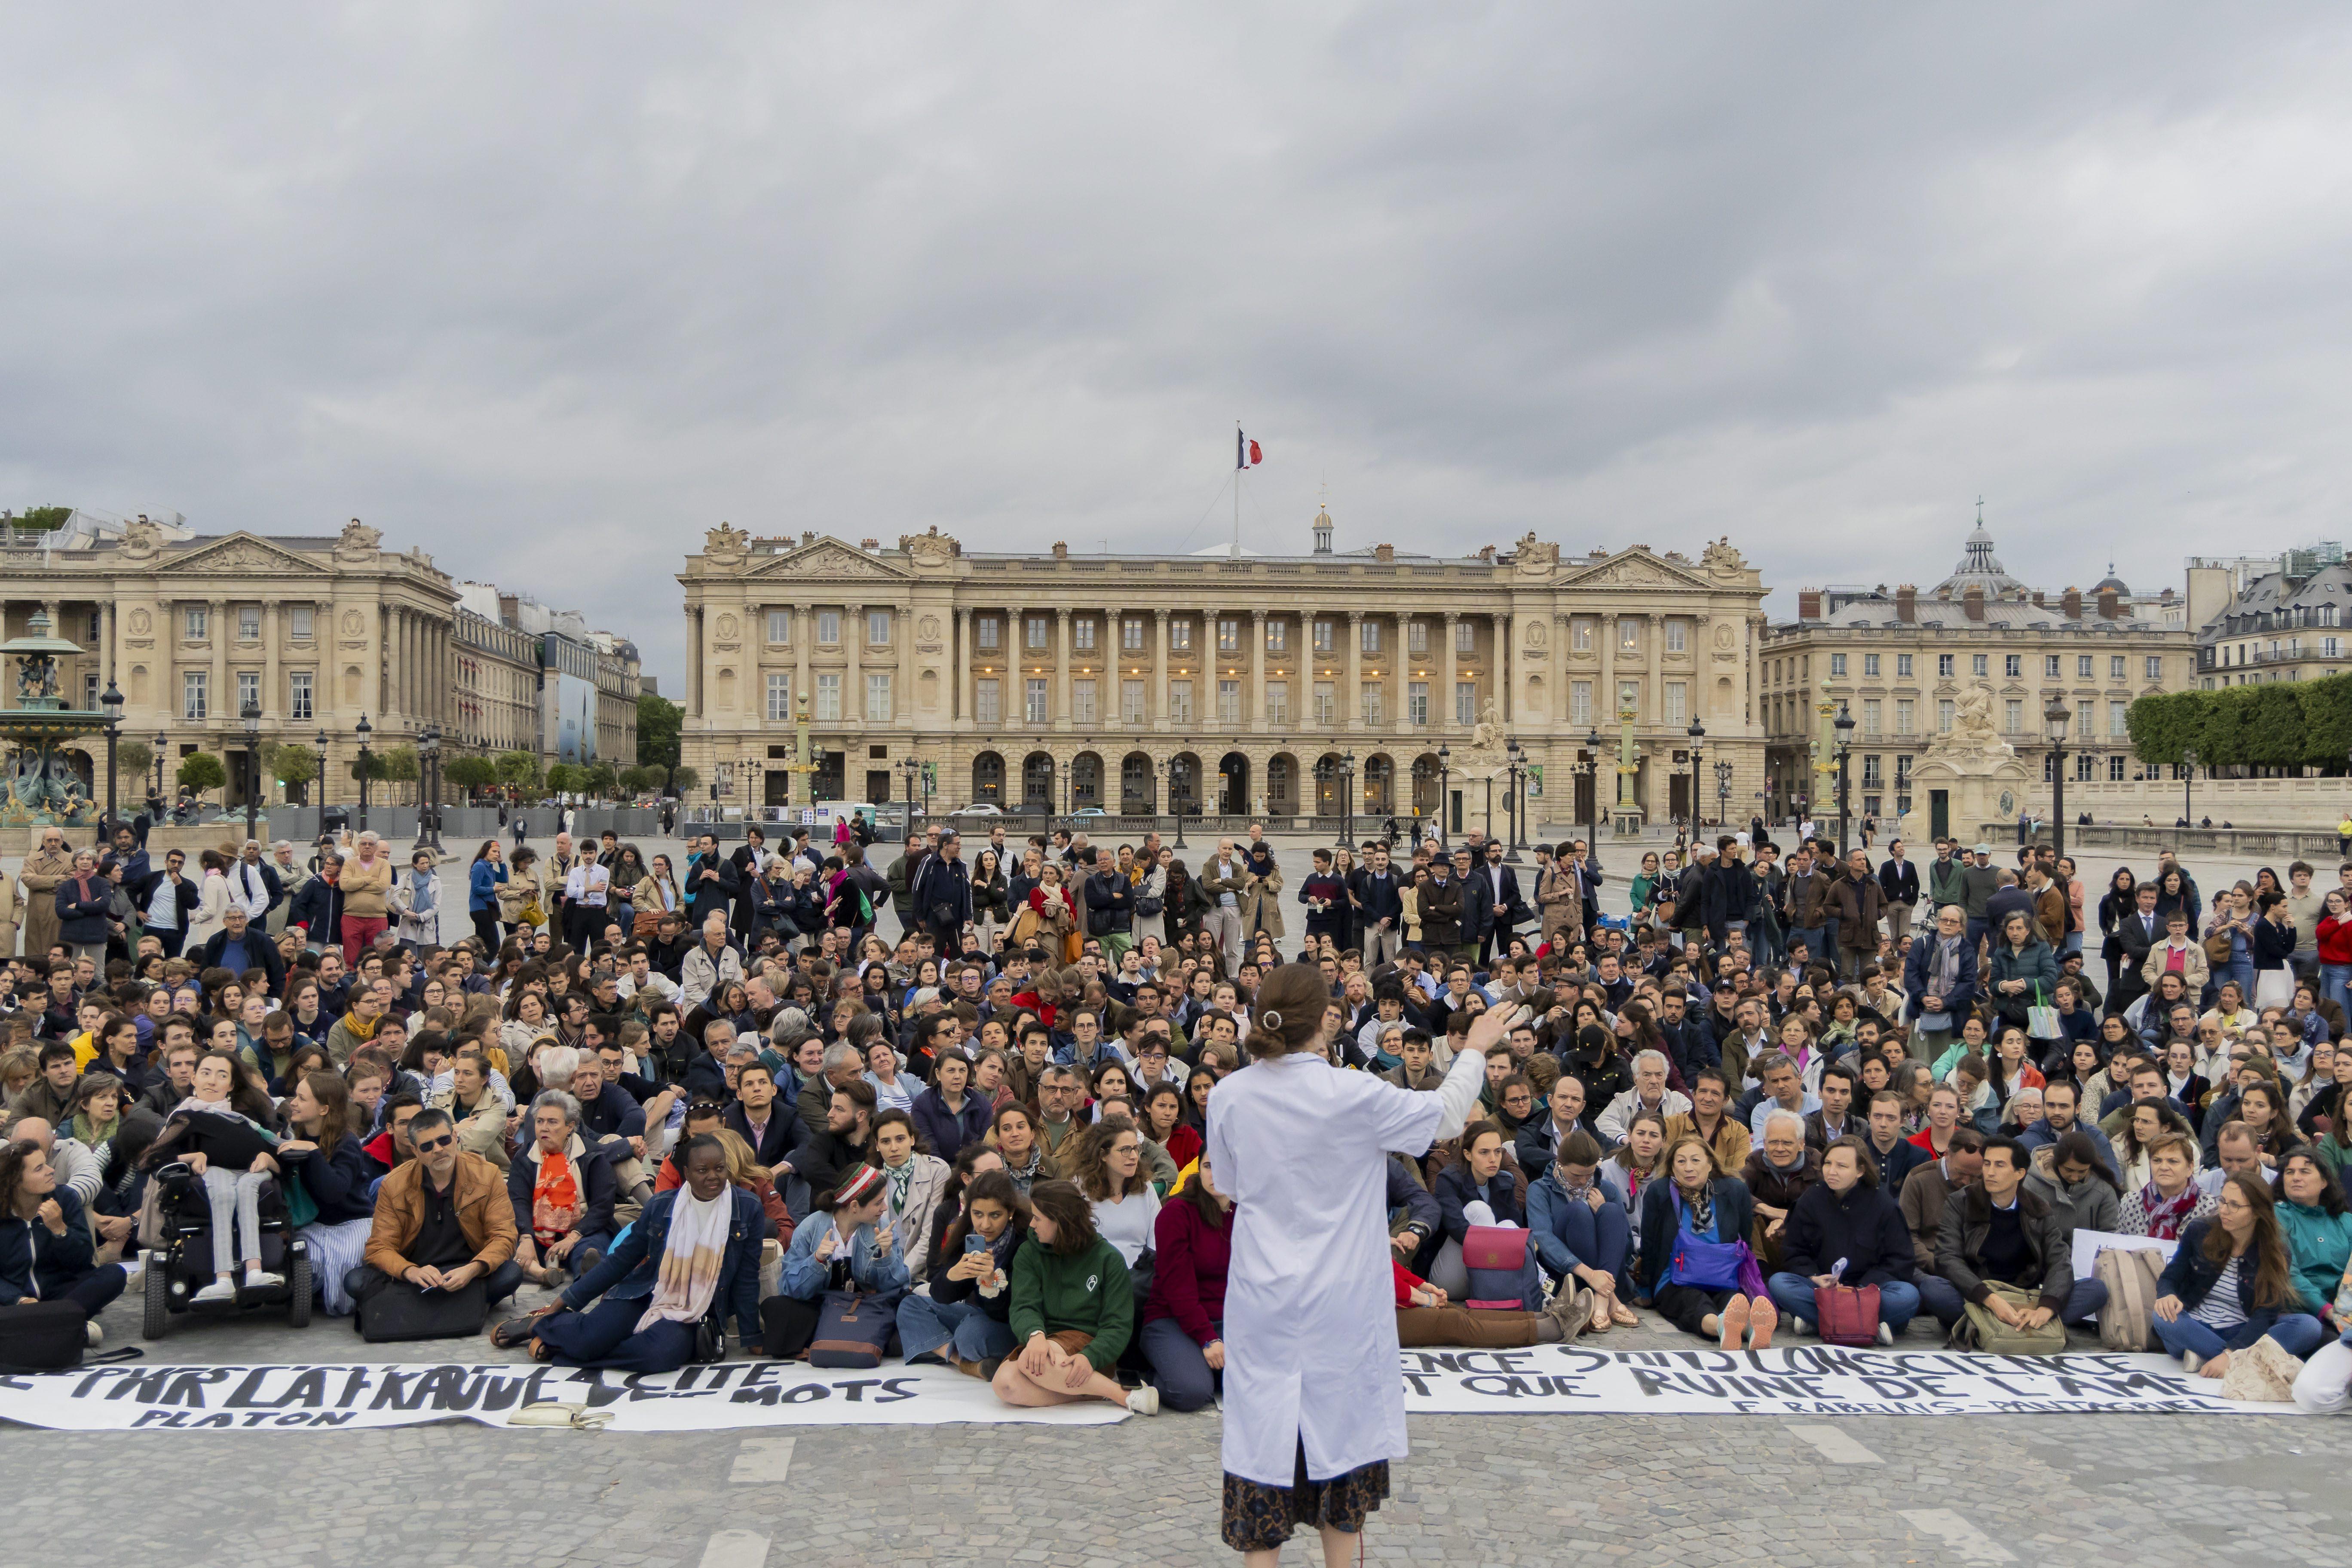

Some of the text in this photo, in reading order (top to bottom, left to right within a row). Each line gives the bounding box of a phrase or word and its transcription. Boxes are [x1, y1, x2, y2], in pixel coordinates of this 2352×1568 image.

[1400, 1351, 1544, 1374] ENCE
[729, 1378, 922, 1406] MOTS
[1460, 1375, 1602, 1398] QUE
[1628, 1367, 1846, 1399] RUINE
[1857, 1375, 1971, 1399] DE
[129, 1410, 358, 1427] PLATON
